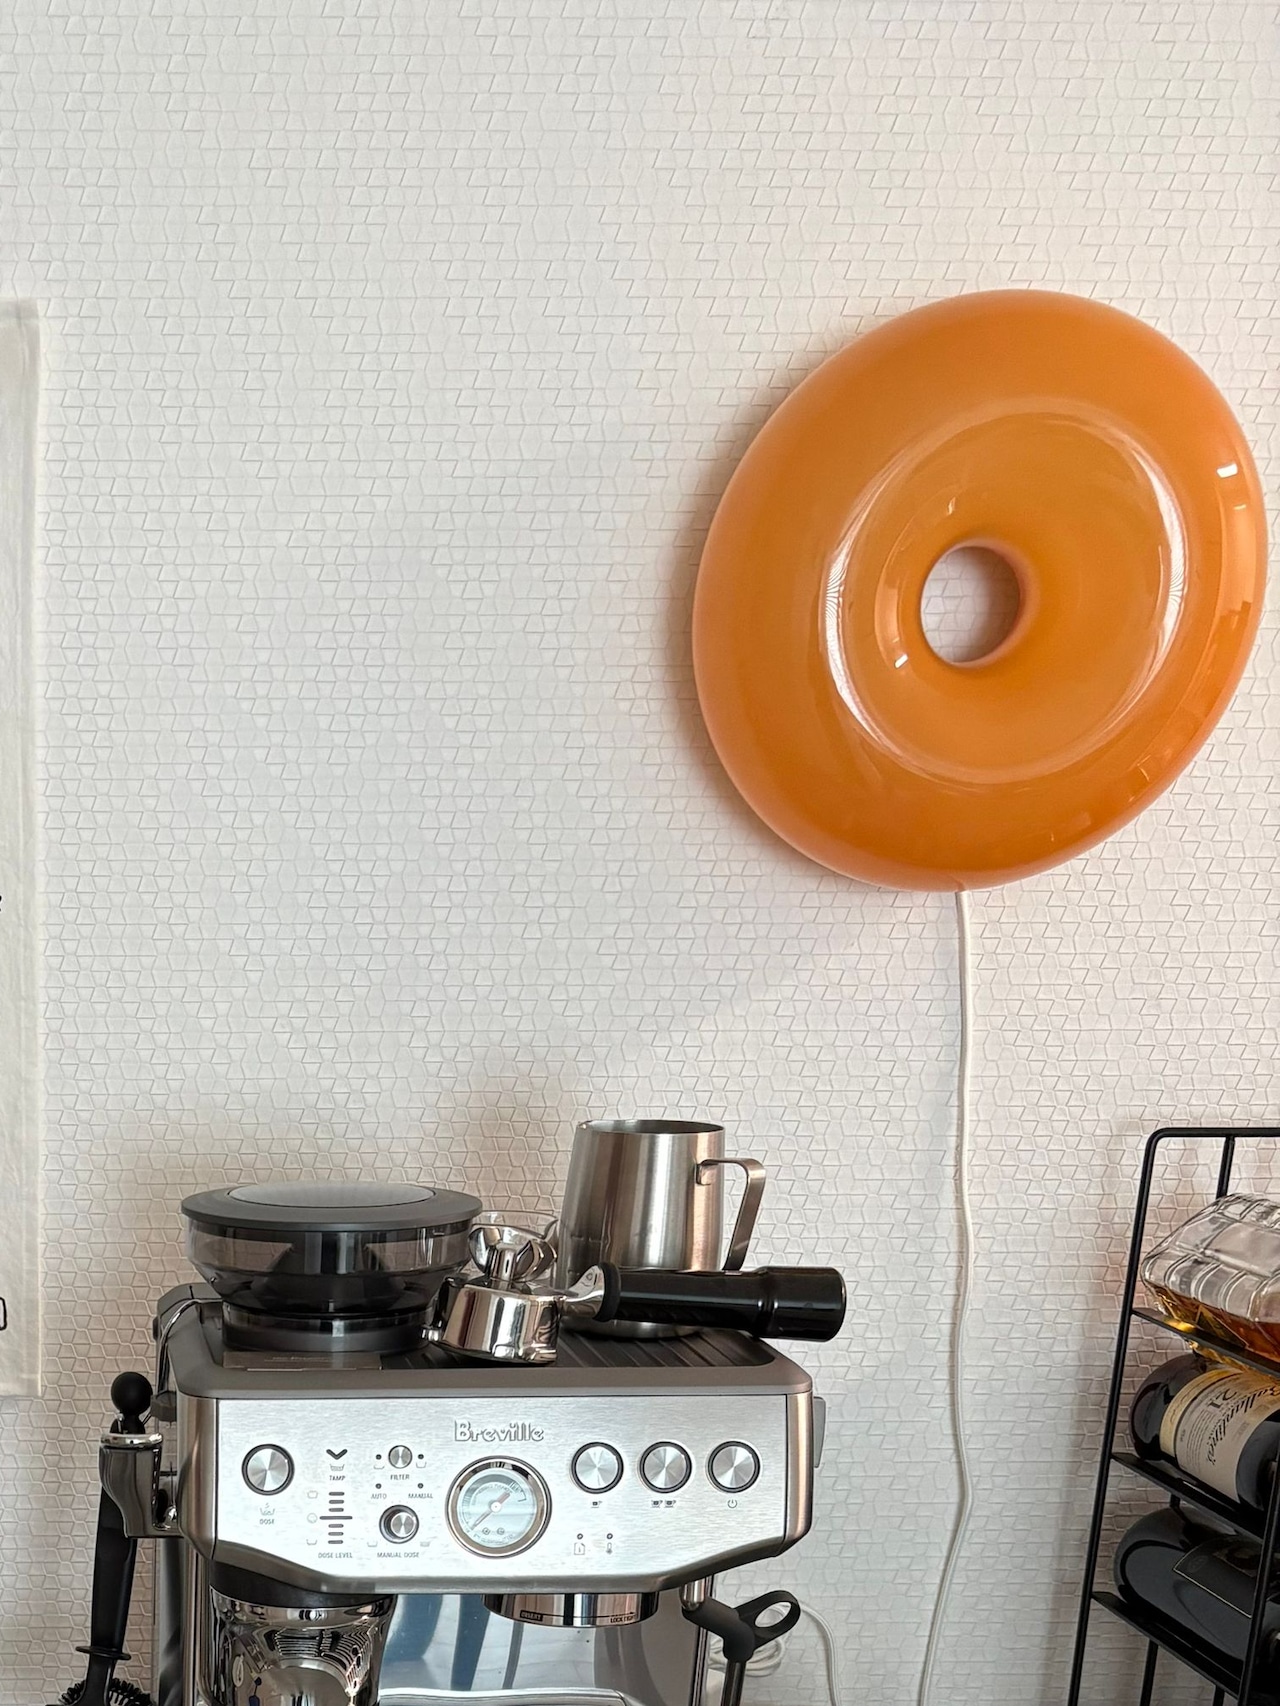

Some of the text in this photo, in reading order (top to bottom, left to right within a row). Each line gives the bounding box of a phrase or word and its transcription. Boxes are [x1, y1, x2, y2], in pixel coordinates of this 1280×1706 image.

[454, 1419, 544, 1442] Breville
[328, 1474, 346, 1482] TAMP
[389, 1473, 411, 1481] FILTER
[317, 1551, 354, 1559] DOSE LEVEL
[376, 1551, 420, 1559] MANUAL DOSE
